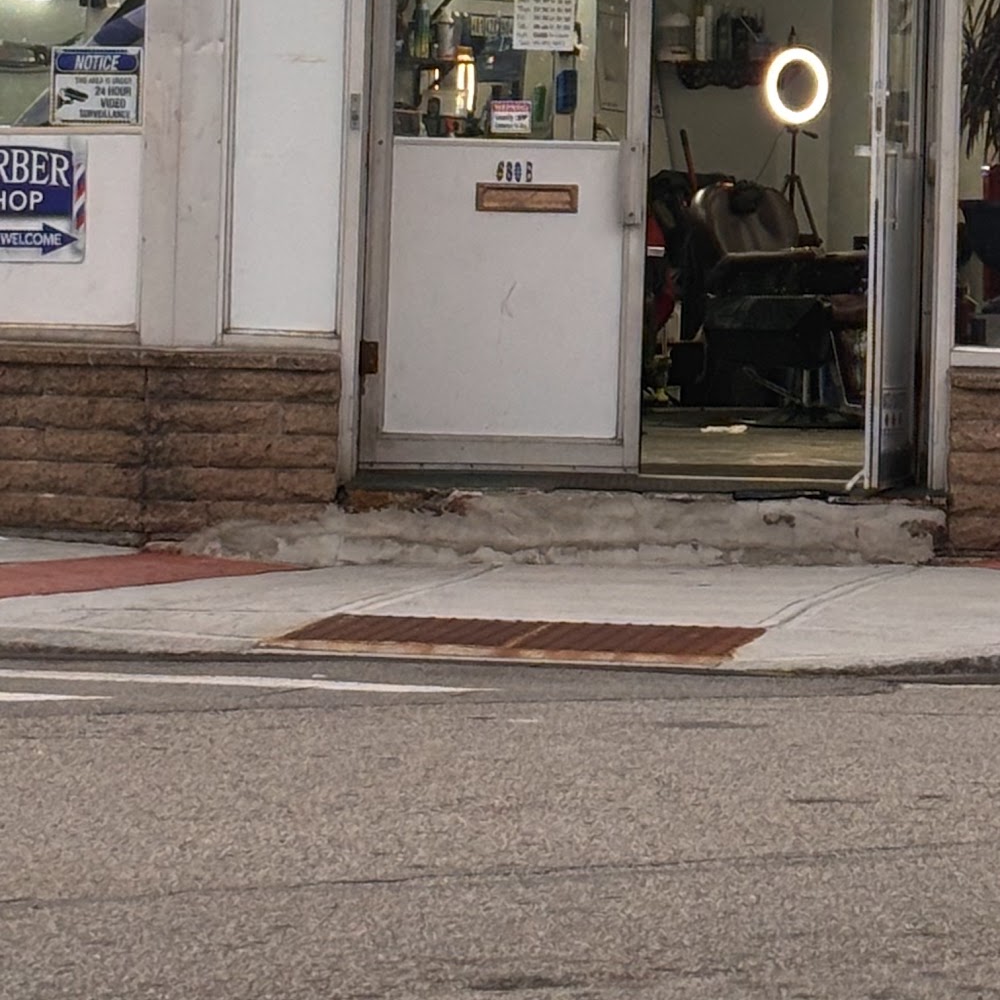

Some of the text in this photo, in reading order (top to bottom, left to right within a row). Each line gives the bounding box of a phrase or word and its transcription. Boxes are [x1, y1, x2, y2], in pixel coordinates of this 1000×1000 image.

[73, 53, 121, 72] NOTICE
[94, 86, 132, 97] 24 HOUR
[100, 98, 127, 109] VIDEO
[496, 160, 522, 183] 680
[0, 232, 62, 247] WELCOME
